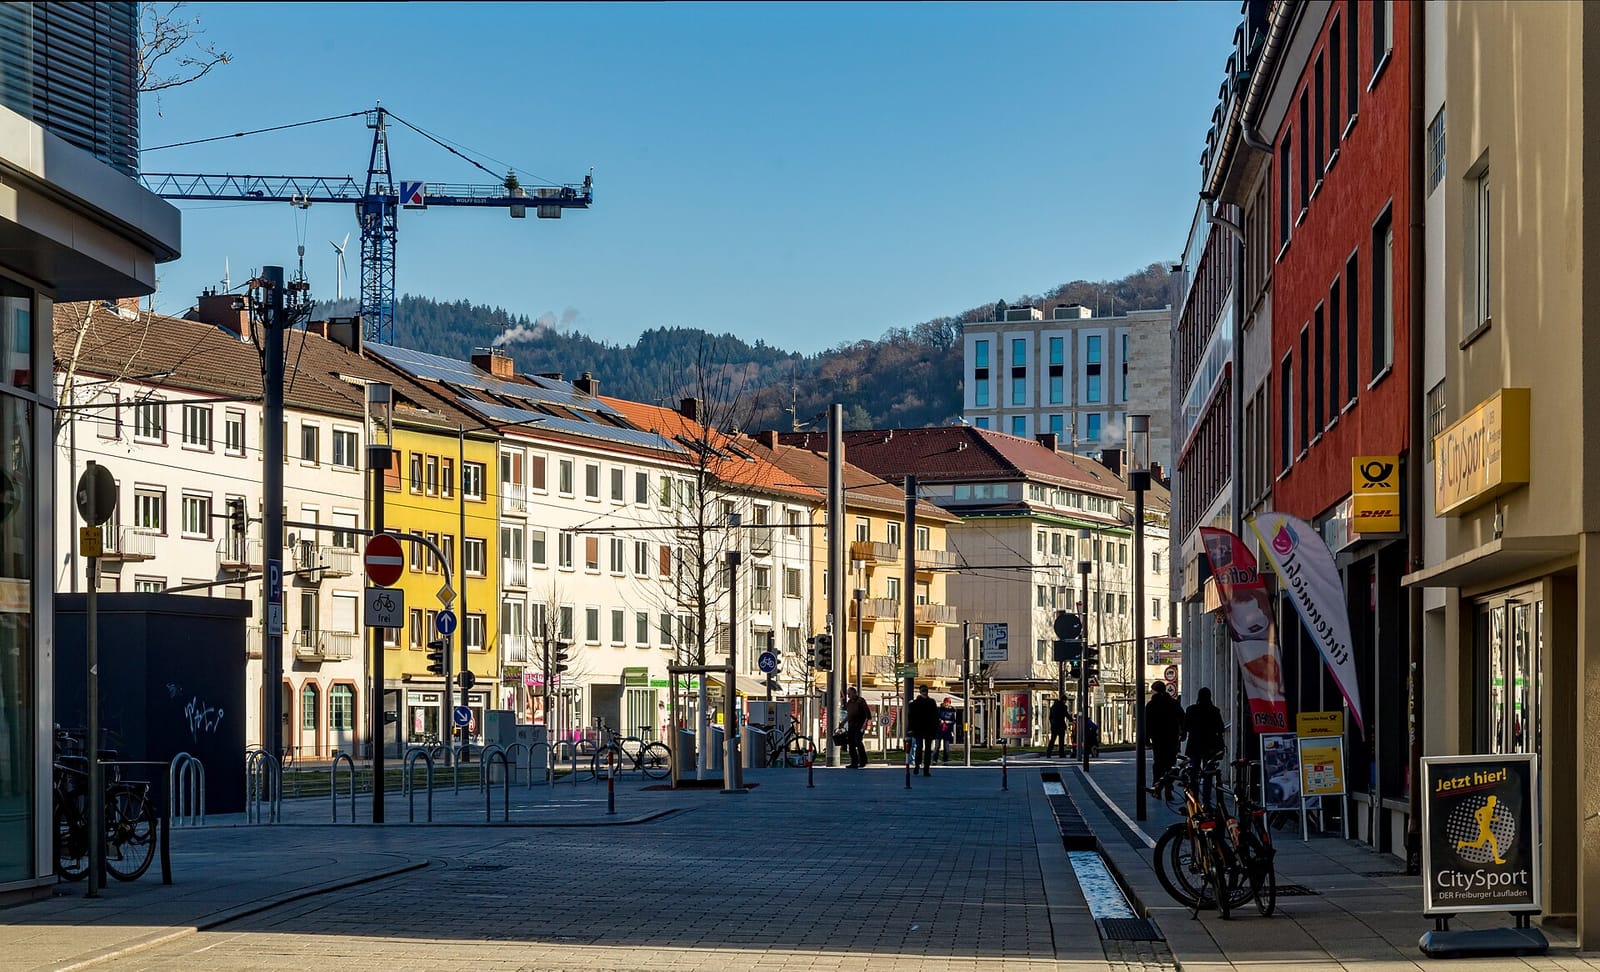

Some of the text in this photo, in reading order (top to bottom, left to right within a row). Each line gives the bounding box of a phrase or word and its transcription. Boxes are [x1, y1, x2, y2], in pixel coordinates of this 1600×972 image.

[1448, 421, 1485, 496] CitySport
[1360, 510, 1393, 518] DHL
[378, 614, 391, 623] frei
[1436, 768, 1507, 792] Jetzt hier!
[1437, 869, 1528, 890] CitySport
[1440, 889, 1528, 900] DER Freiburger Laufladen
